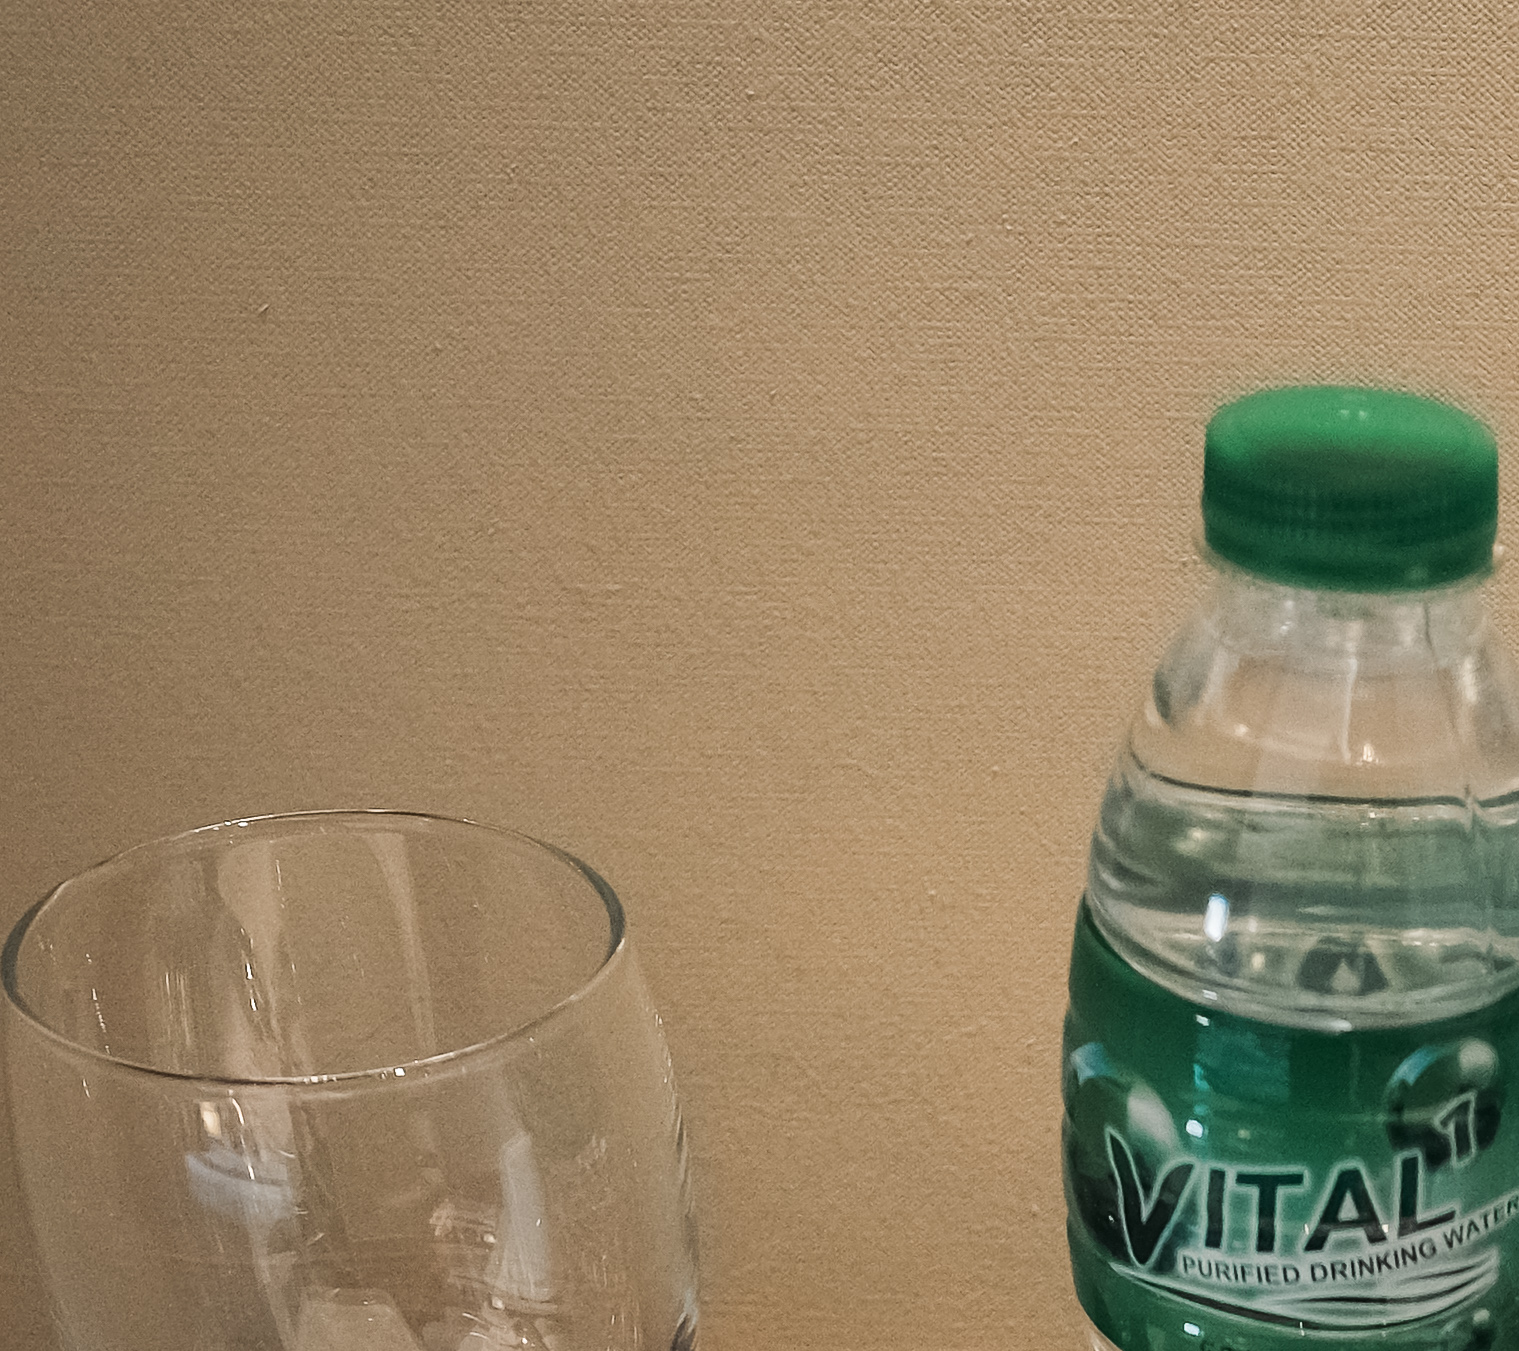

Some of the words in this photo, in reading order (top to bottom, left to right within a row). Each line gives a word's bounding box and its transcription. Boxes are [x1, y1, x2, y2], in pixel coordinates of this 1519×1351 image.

[1107, 1127, 1456, 1267] VITAL
[1183, 1255, 1300, 1286] PURIFIED
[1310, 1241, 1437, 1283] DRINKING
